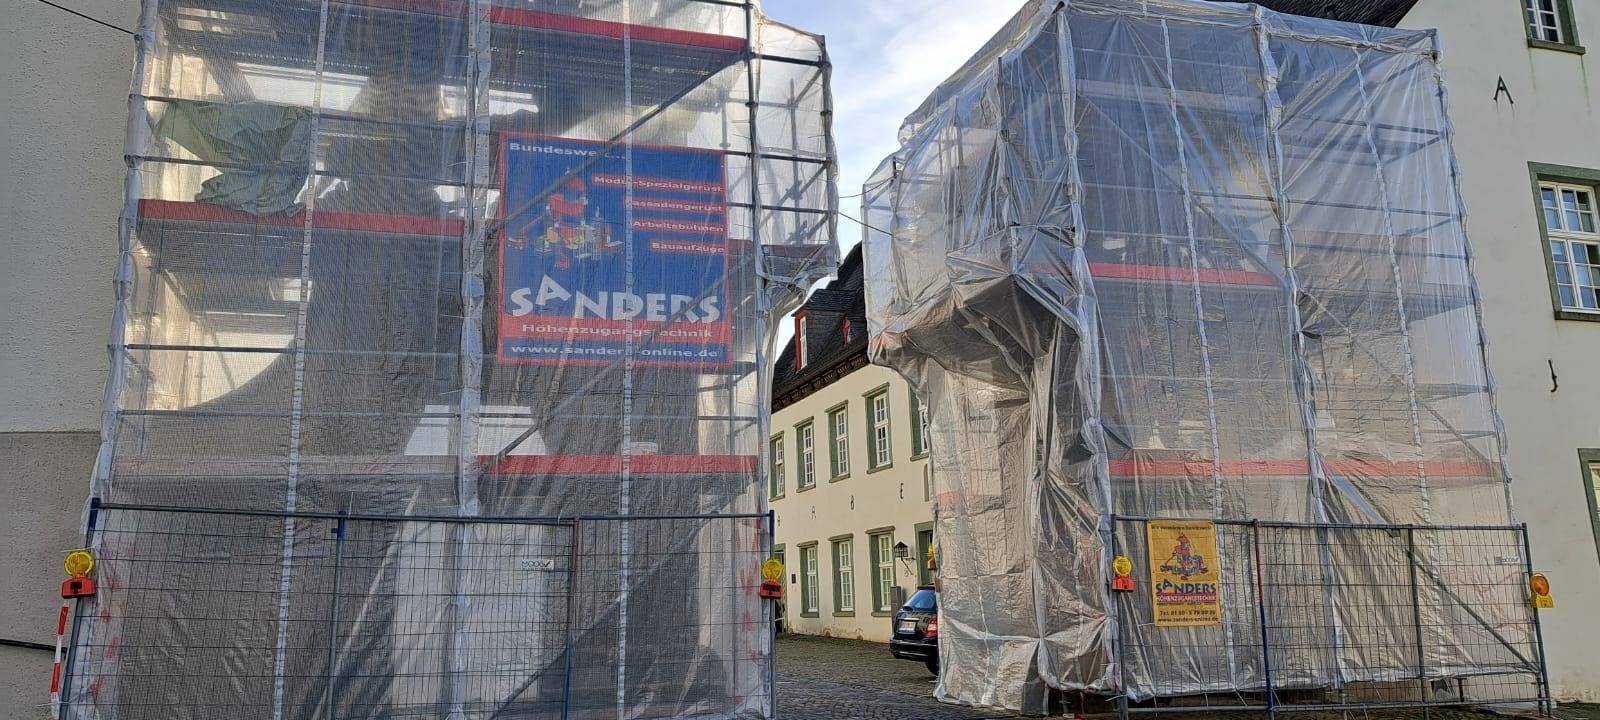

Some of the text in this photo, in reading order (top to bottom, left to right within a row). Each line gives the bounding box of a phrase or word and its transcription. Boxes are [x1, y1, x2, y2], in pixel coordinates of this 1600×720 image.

[594, 176, 723, 193] Modu-Spezialgerüst
[627, 200, 723, 212] assadengerüst
[652, 242, 724, 254] Bauaufzüge
[510, 274, 721, 323] SANDERS
[522, 324, 713, 338] Höhenzugagsechnik
[511, 344, 719, 357] www.sander-online.de
[1155, 578, 1216, 594] SANDERS
